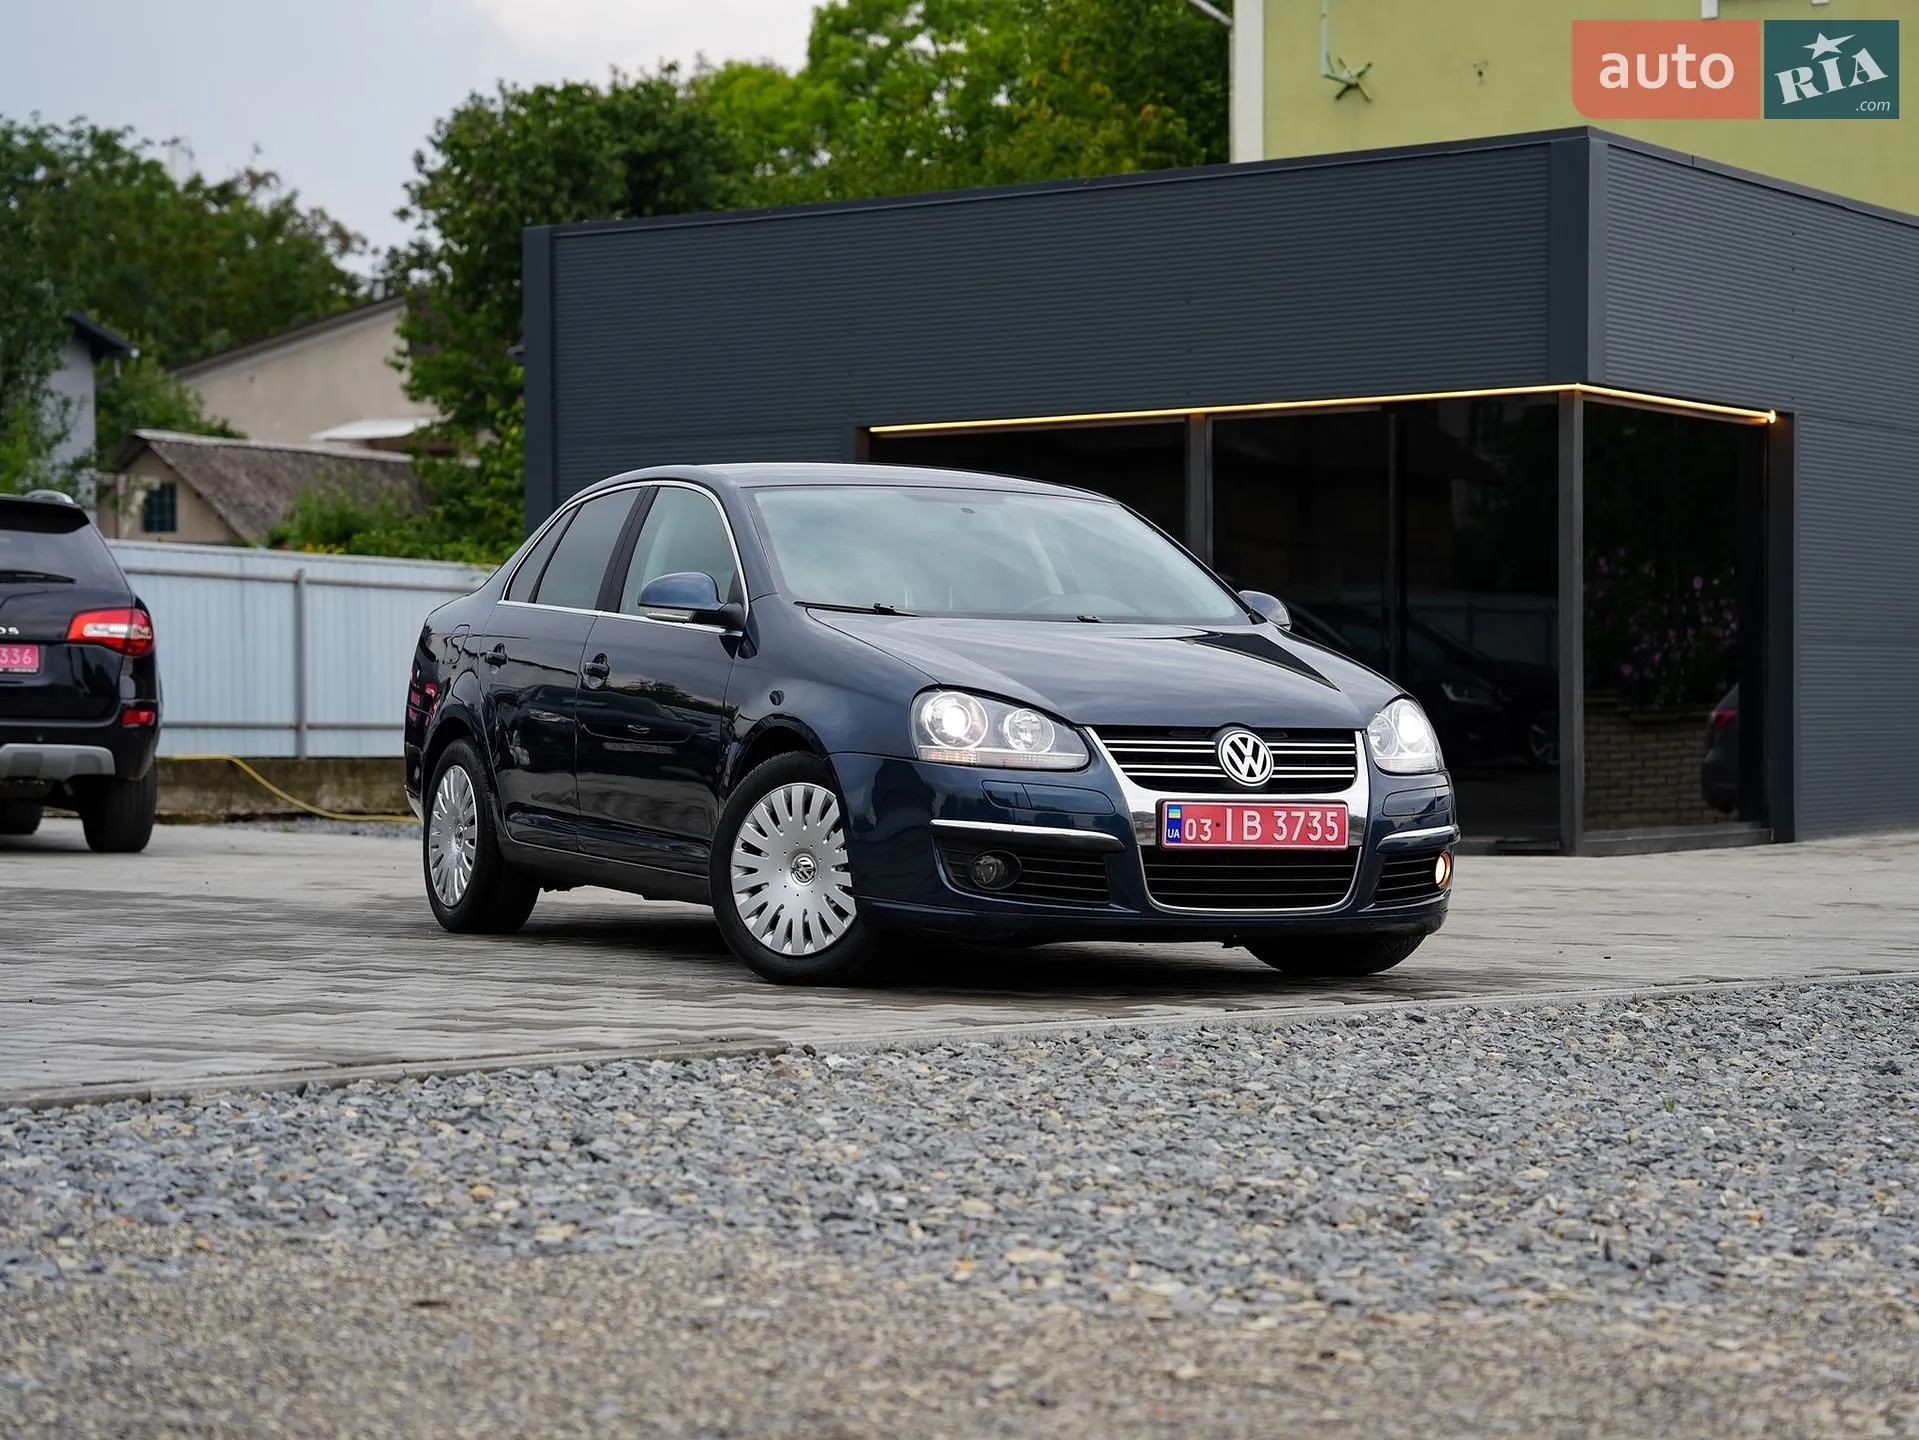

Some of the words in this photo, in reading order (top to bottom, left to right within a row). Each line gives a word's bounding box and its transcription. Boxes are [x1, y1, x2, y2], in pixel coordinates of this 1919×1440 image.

[1167, 828, 1181, 839] UA
[1184, 818, 1213, 841] 03
[1272, 810, 1339, 842] 3735
